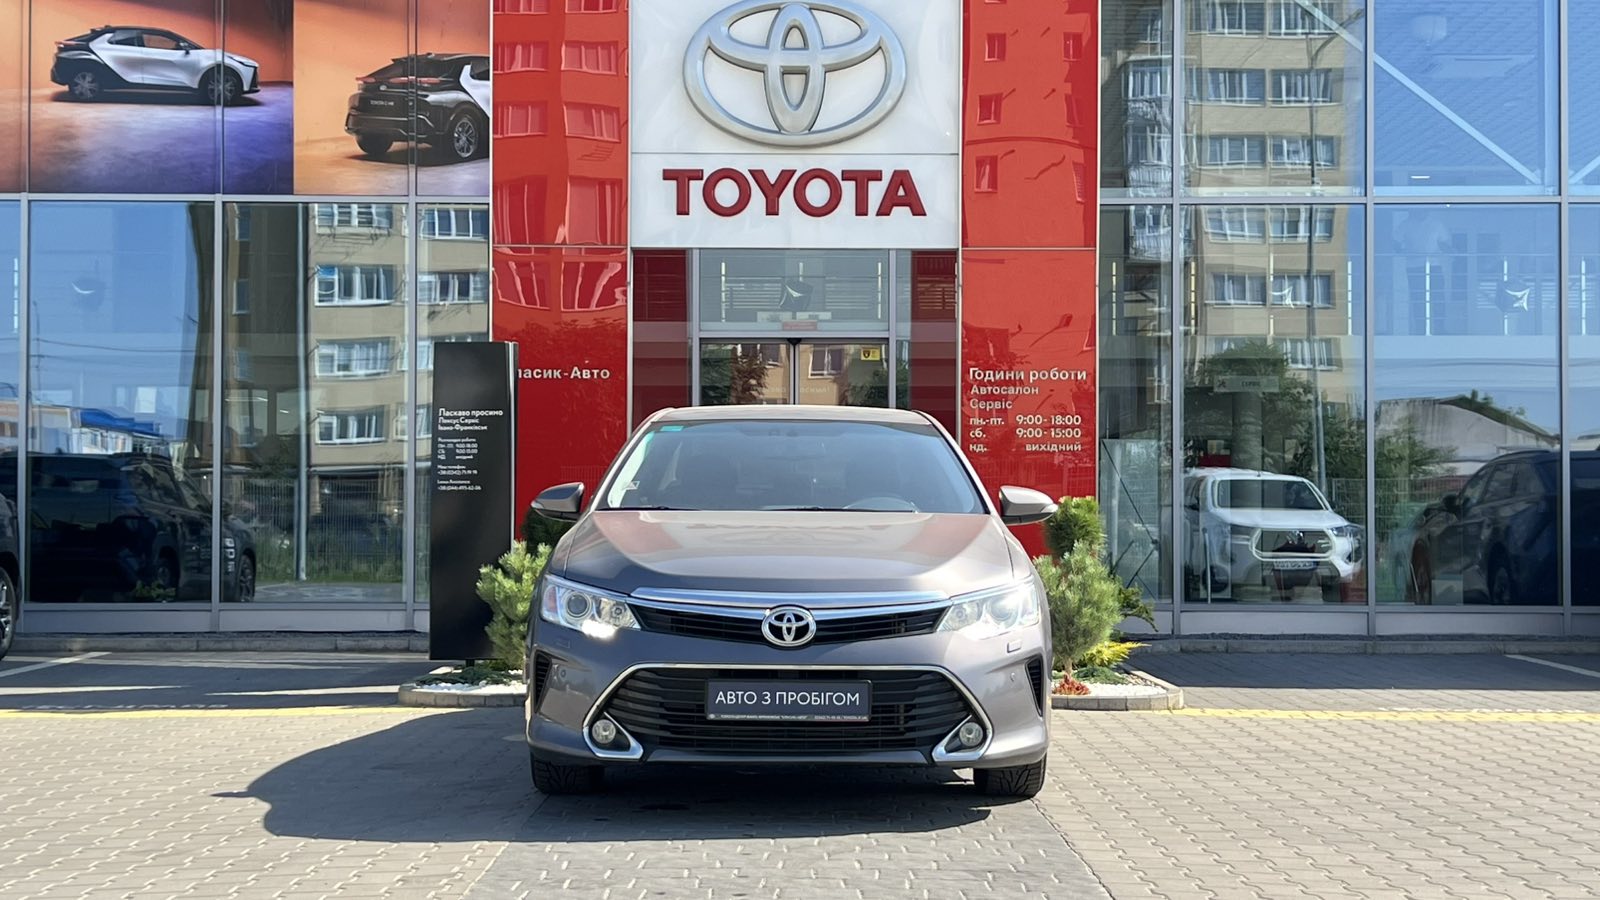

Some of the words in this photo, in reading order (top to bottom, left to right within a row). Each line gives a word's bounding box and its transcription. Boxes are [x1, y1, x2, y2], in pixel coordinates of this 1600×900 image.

[663, 168, 927, 217] TOYOTA
[969, 368, 1024, 382] Години
[1030, 368, 1087, 383] роботи
[971, 385, 1039, 395] Автосалон
[970, 399, 1013, 411] Сервіс
[471, 410, 504, 418] просимо
[1016, 415, 1042, 425] 9:00
[1051, 415, 1081, 425] 18:00
[970, 428, 986, 438] сб.
[1016, 428, 1042, 438] 9:00
[1051, 428, 1081, 438] 15:00
[970, 443, 987, 452] нд.
[1025, 442, 1081, 452] вихідний
[715, 691, 757, 704] АВТО
[762, 691, 771, 705] З
[776, 692, 860, 706] ПРОБІГОМ
